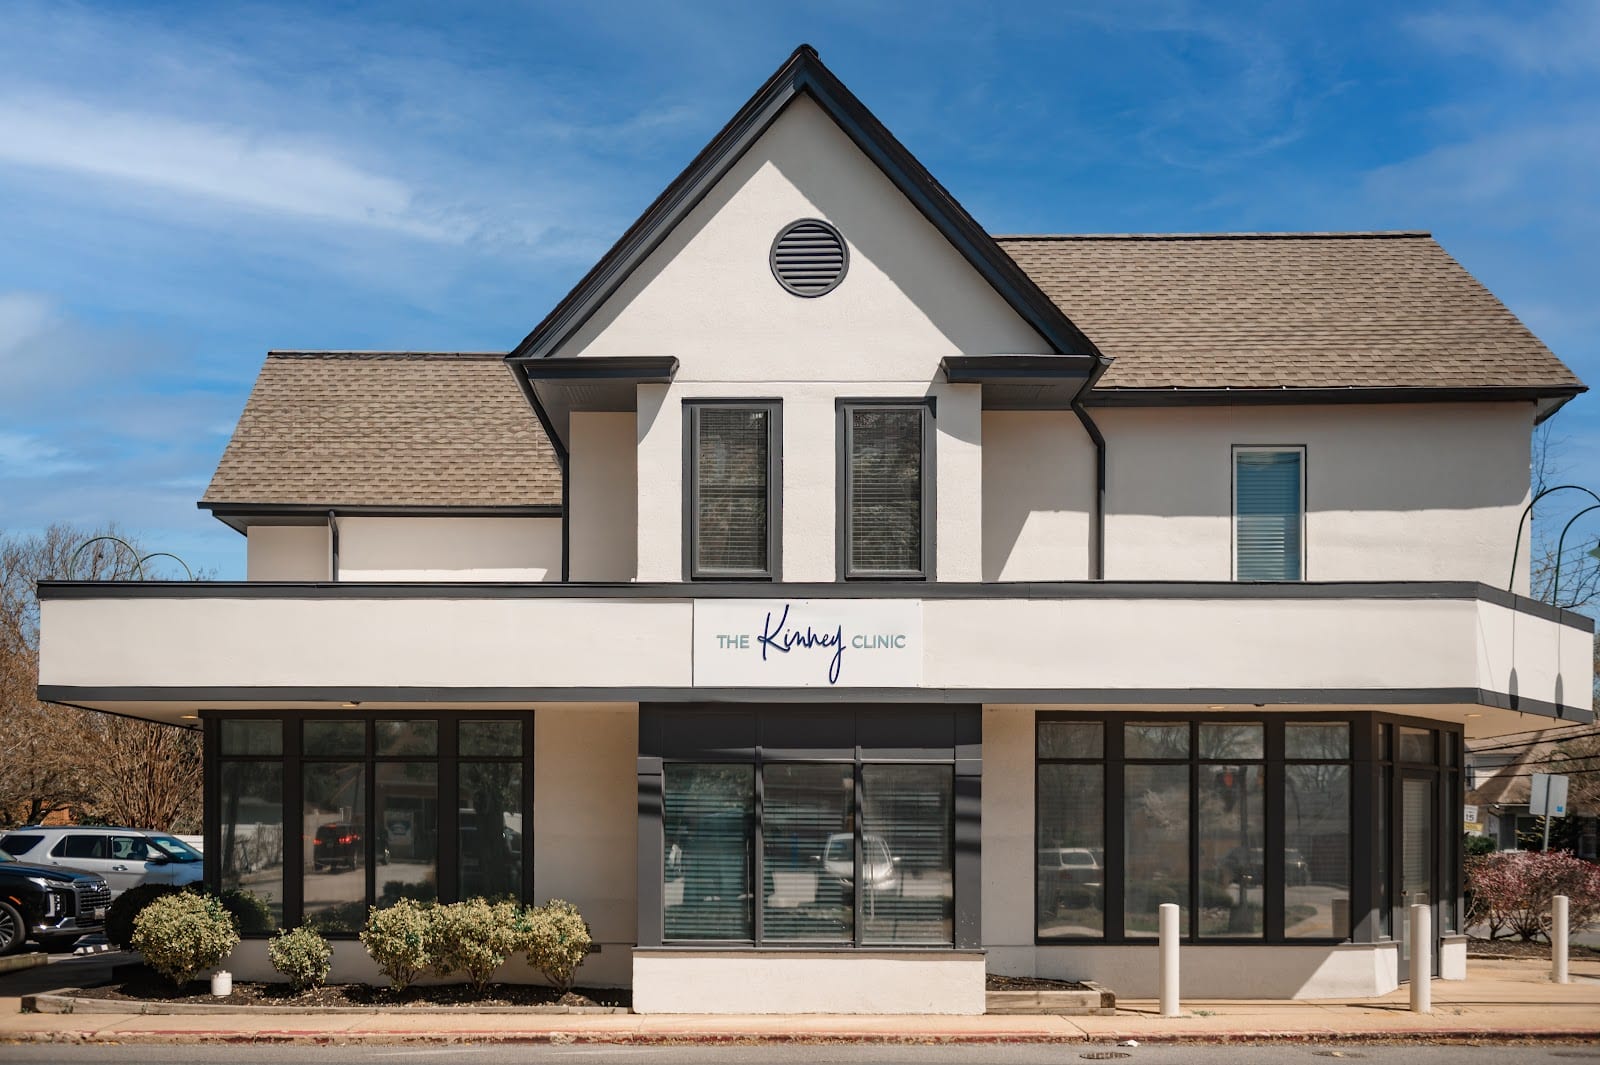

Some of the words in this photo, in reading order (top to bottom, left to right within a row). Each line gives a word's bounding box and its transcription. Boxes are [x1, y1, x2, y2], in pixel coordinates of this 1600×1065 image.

[716, 634, 750, 649] THE
[757, 604, 846, 685] Kinney
[851, 634, 906, 649] CLINIC
